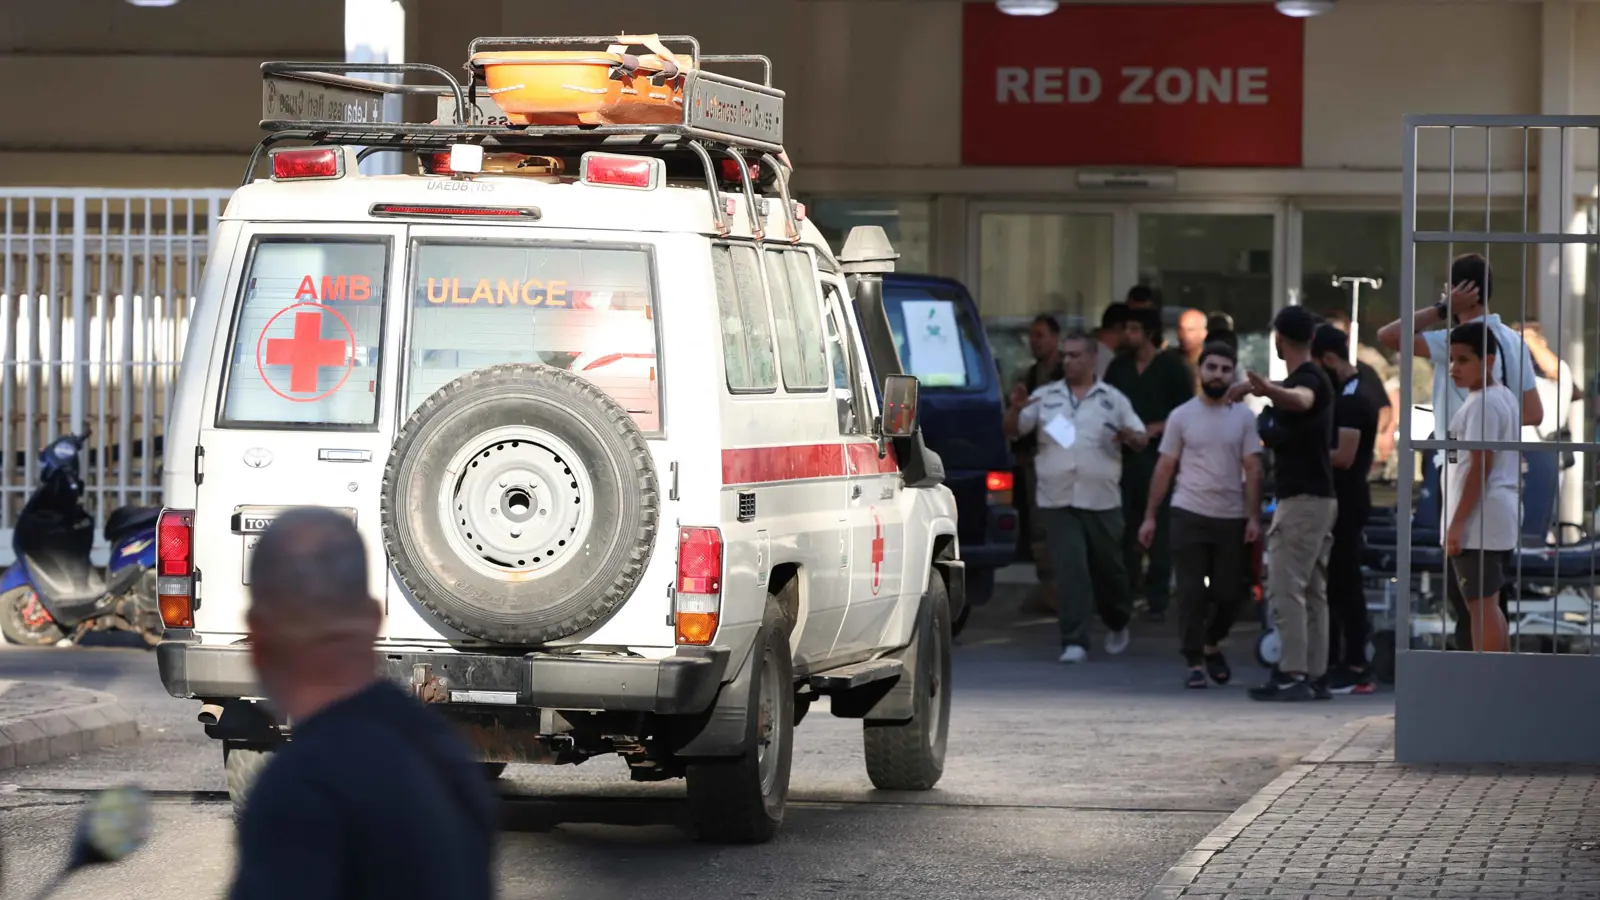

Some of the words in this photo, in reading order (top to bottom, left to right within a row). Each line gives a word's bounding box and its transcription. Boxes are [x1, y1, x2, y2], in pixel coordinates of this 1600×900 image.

[996, 67, 1101, 104] RED
[1118, 67, 1268, 104] ZONE
[295, 275, 370, 300] AMB
[427, 278, 567, 306] ULANCE
[247, 519, 275, 529] TOY
